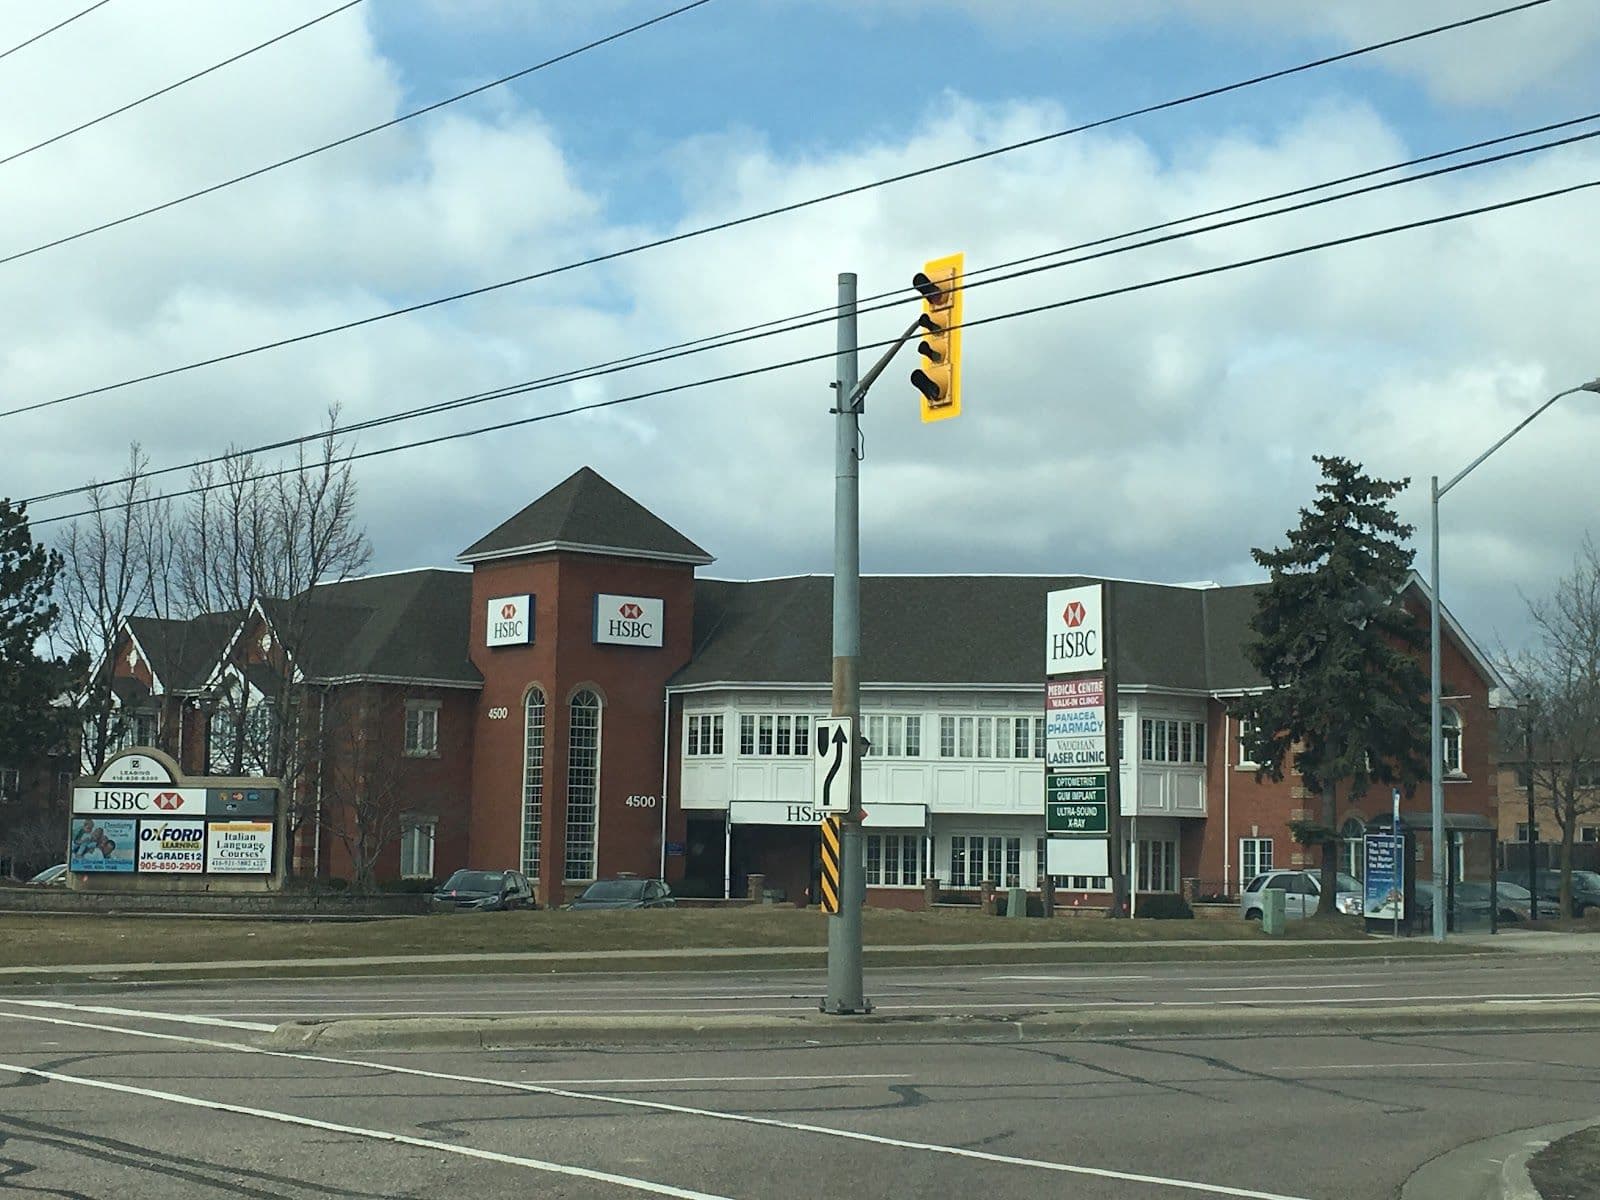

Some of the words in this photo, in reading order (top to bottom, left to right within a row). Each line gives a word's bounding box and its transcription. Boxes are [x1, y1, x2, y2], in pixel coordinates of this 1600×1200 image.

[494, 620, 523, 639] HSBC
[608, 619, 653, 639] HSBC
[1052, 630, 1096, 660] HSBC
[1048, 683, 1077, 696] MEDICAL
[1077, 681, 1104, 693] CENTRE
[1052, 698, 1078, 707] WALK-IN
[1079, 696, 1099, 706] CLINIC
[488, 707, 508, 720] 4500
[1055, 711, 1096, 722] PANACEA
[1048, 720, 1104, 734] PHARMACY
[1048, 752, 1074, 764] LASER
[1075, 750, 1104, 763] CLINIC
[1056, 776, 1097, 787] OPTOMETRIST
[93, 791, 149, 810] HSBC
[625, 795, 656, 808] 4500
[1056, 791, 1071, 801] GUM
[1071, 790, 1097, 800] IMPLANT
[787, 805, 826, 822] HSB
[1056, 806, 1098, 817] ULTRA-SOUND
[1067, 818, 1086, 828] X-RAY
[141, 823, 203, 842] OXFORD
[224, 832, 256, 841] Italian
[161, 841, 200, 849] LEARNING
[220, 849, 259, 858] Courses
